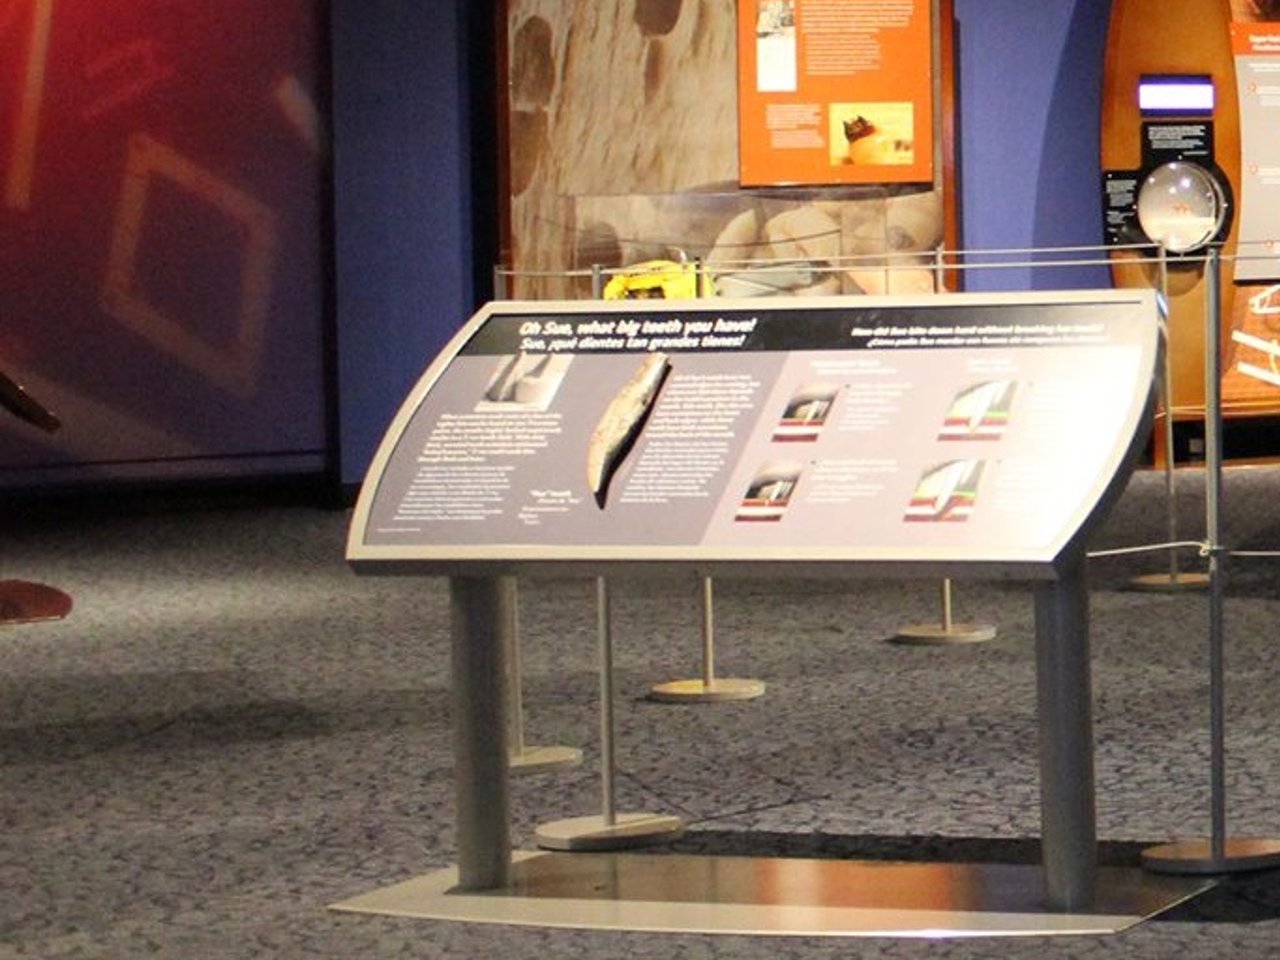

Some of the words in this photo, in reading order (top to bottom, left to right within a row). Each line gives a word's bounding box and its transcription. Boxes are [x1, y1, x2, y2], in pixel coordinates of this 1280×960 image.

[519, 321, 542, 335] Oh
[541, 321, 573, 336] Sue,
[577, 320, 616, 335] what
[615, 319, 641, 337] big
[641, 318, 683, 334] teeth
[683, 321, 714, 339] you
[713, 317, 758, 333] have!
[518, 337, 546, 350] Sue,
[578, 336, 625, 350] dientes
[625, 337, 648, 350] tan
[648, 335, 700, 352] grandes
[700, 334, 747, 348] tienes!
